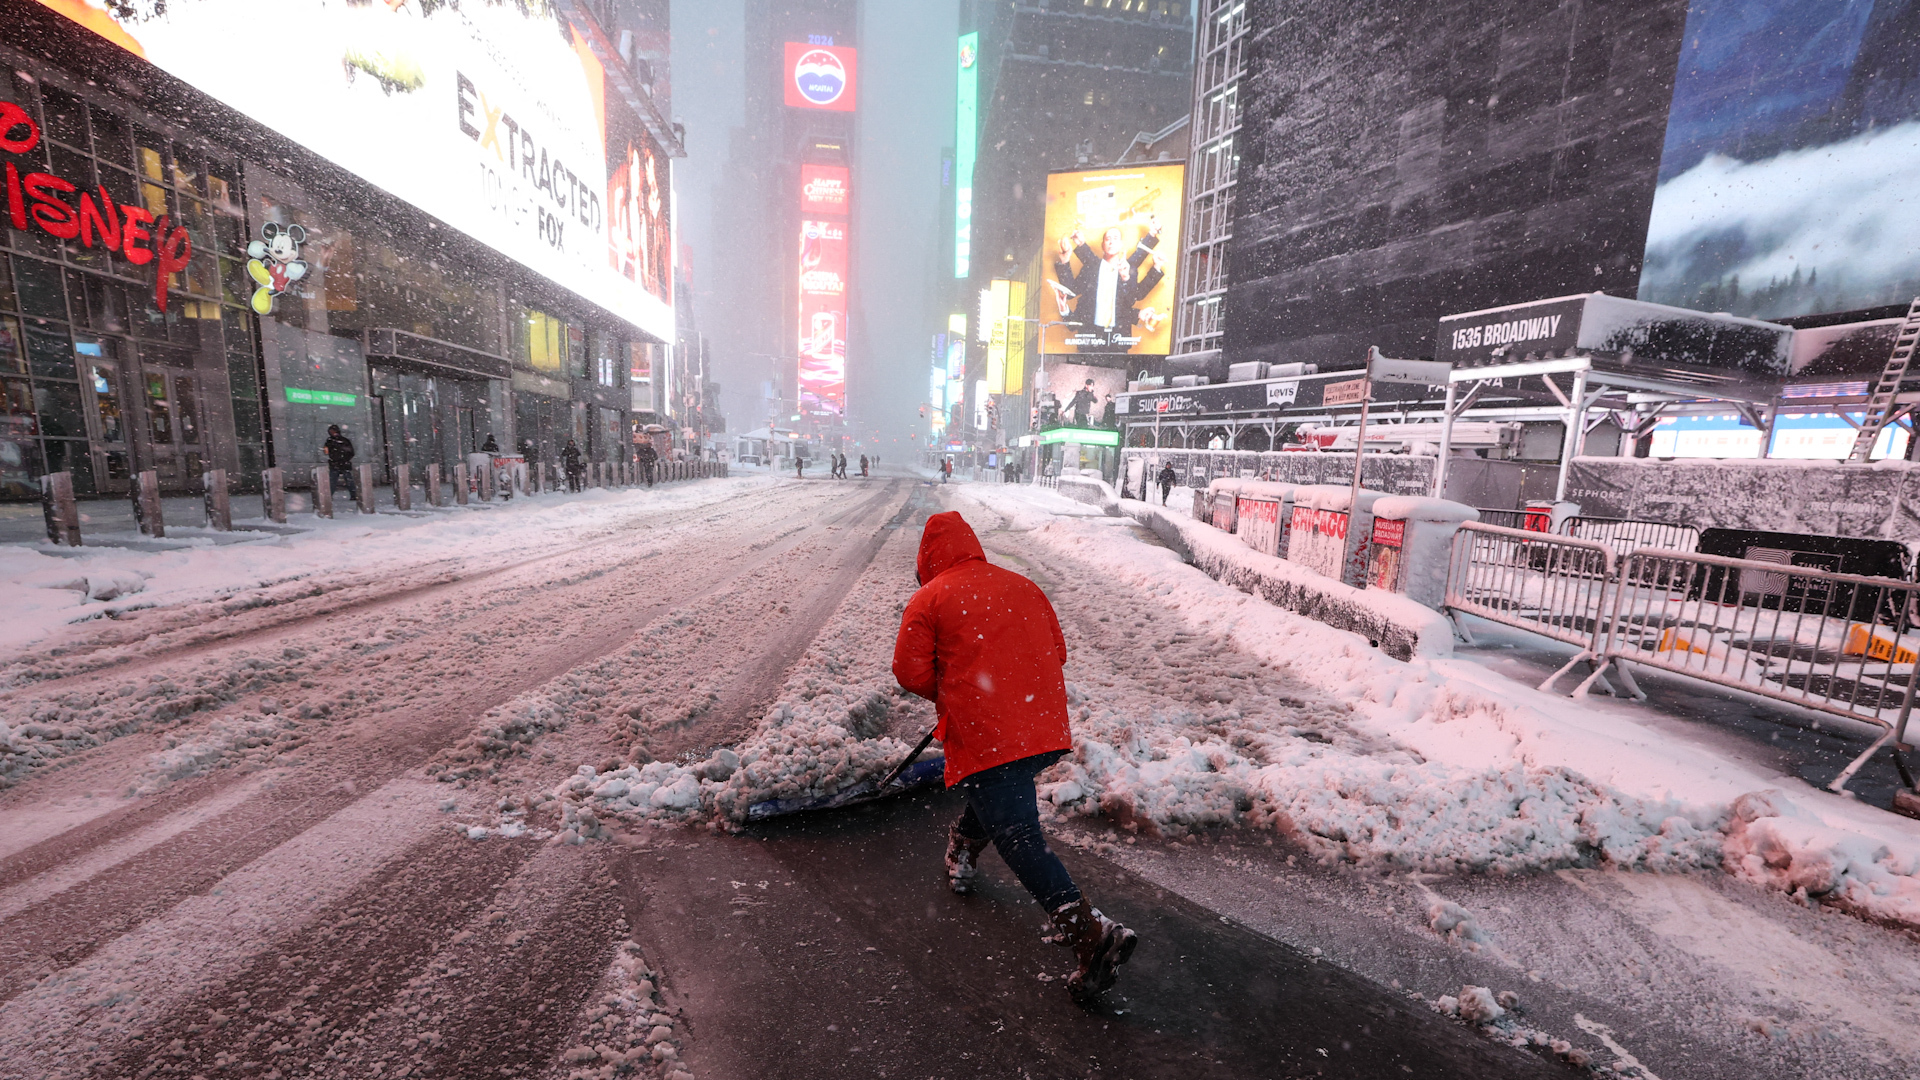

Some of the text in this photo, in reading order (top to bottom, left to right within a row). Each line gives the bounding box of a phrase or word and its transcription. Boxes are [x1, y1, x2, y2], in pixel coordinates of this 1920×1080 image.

[808, 84, 833, 93] MOUTAI
[456, 69, 601, 234] EXTRACTED
[813, 178, 842, 188] HAPPY
[538, 205, 564, 254] FOX
[992, 328, 1004, 337] LION
[1452, 314, 1562, 350] 1535 BROADWAY
[990, 337, 1005, 346] KING
[1572, 488, 1623, 500] SEPHORA
[1239, 499, 1278, 524] CHICAGO
[1292, 507, 1348, 540] CHICAGO
[1375, 520, 1404, 532] MUSEUM OF
[1374, 529, 1402, 541] BROADWAY
[1792, 581, 1828, 591] ALLANCE
